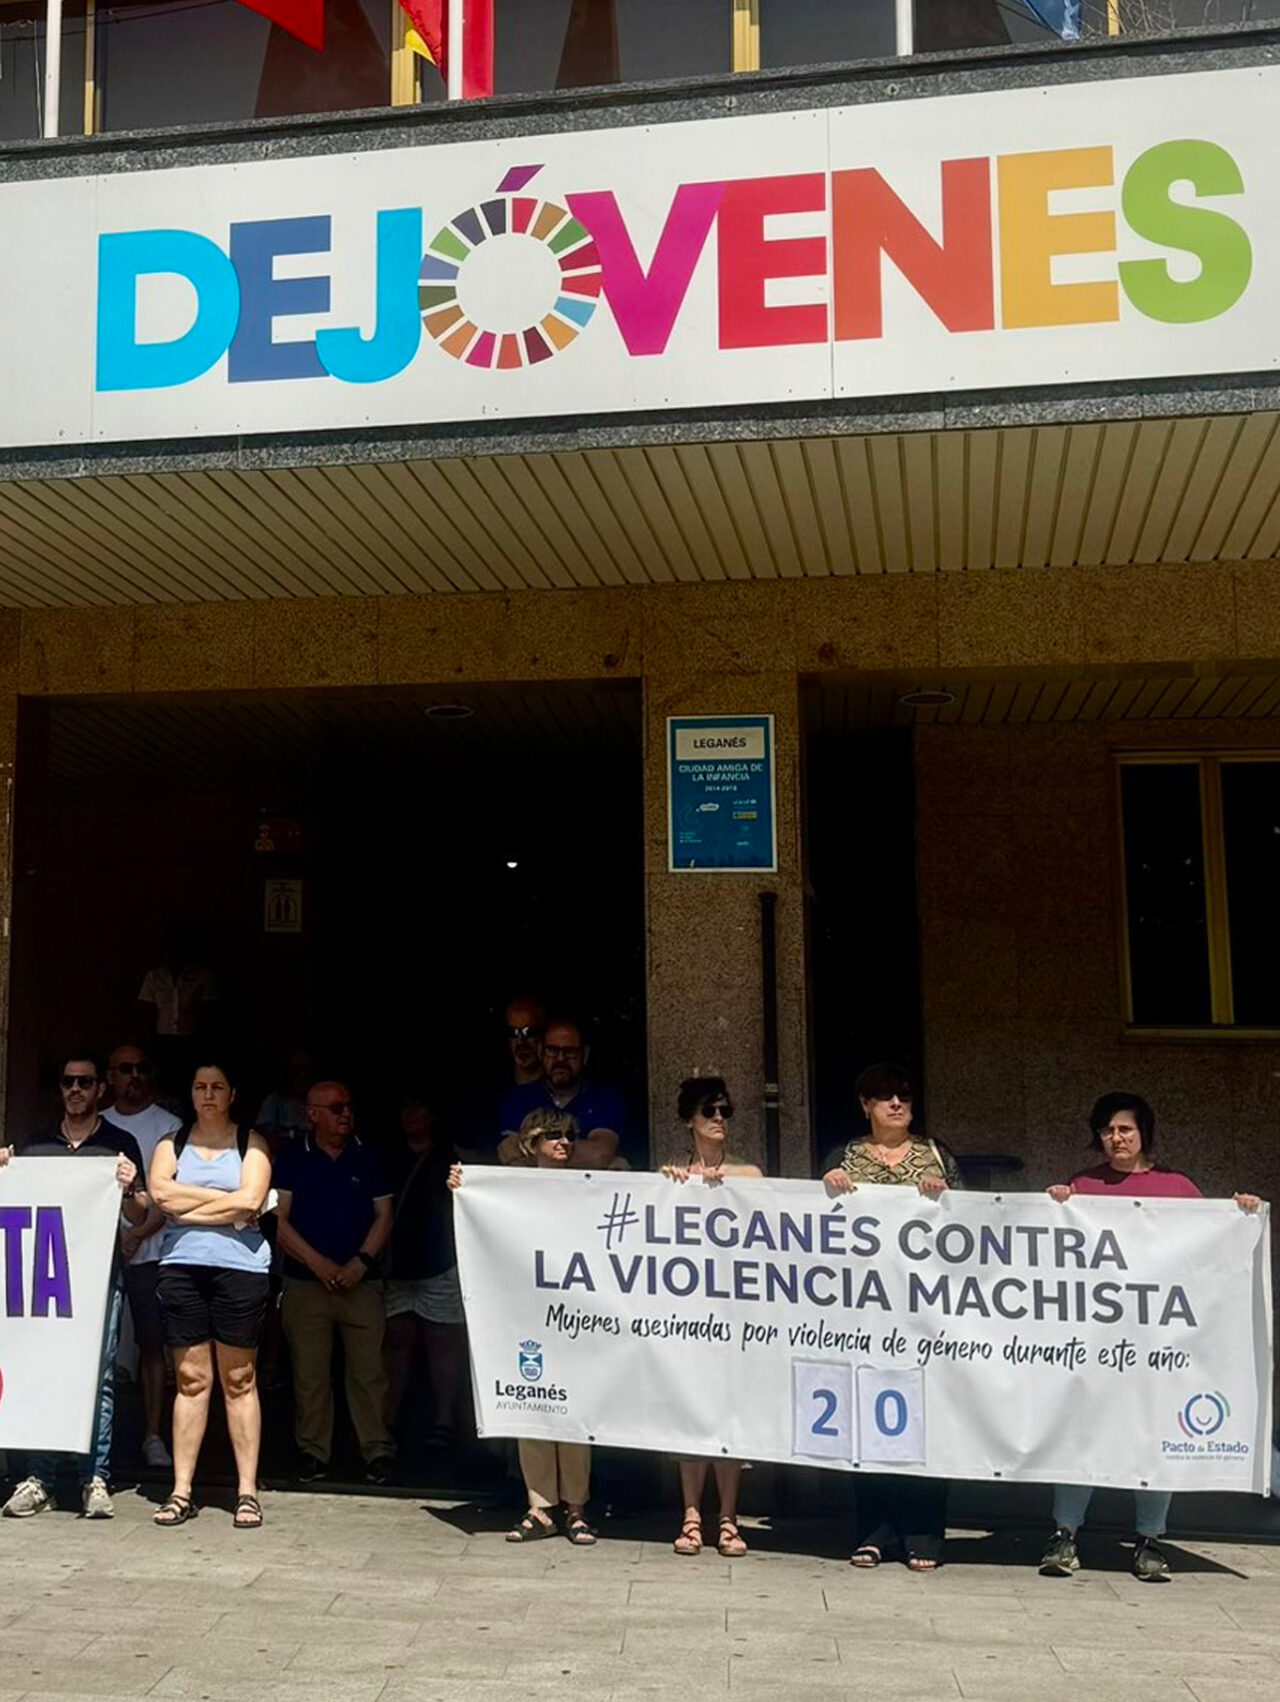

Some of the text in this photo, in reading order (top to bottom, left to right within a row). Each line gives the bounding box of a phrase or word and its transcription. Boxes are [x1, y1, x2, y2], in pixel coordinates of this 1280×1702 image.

[693, 737, 747, 749] LEGANÉS
[678, 763, 764, 773] CIUDAD AMIGA DE
[692, 772, 750, 782] LA INFANCIA
[597, 1192, 1129, 1270] #LEGANÉS CONTRA
[534, 1249, 1198, 1328] LA VIOLENCIA MACHISTA
[545, 1303, 1191, 1372] Mujeres asesinadas por violencia de género durante este año:
[495, 1380, 567, 1401] Leganés
[495, 1401, 568, 1415] AYUNTAMIENTO
[1162, 1441, 1195, 1454] Pacto
[1207, 1441, 1249, 1455] Estado
